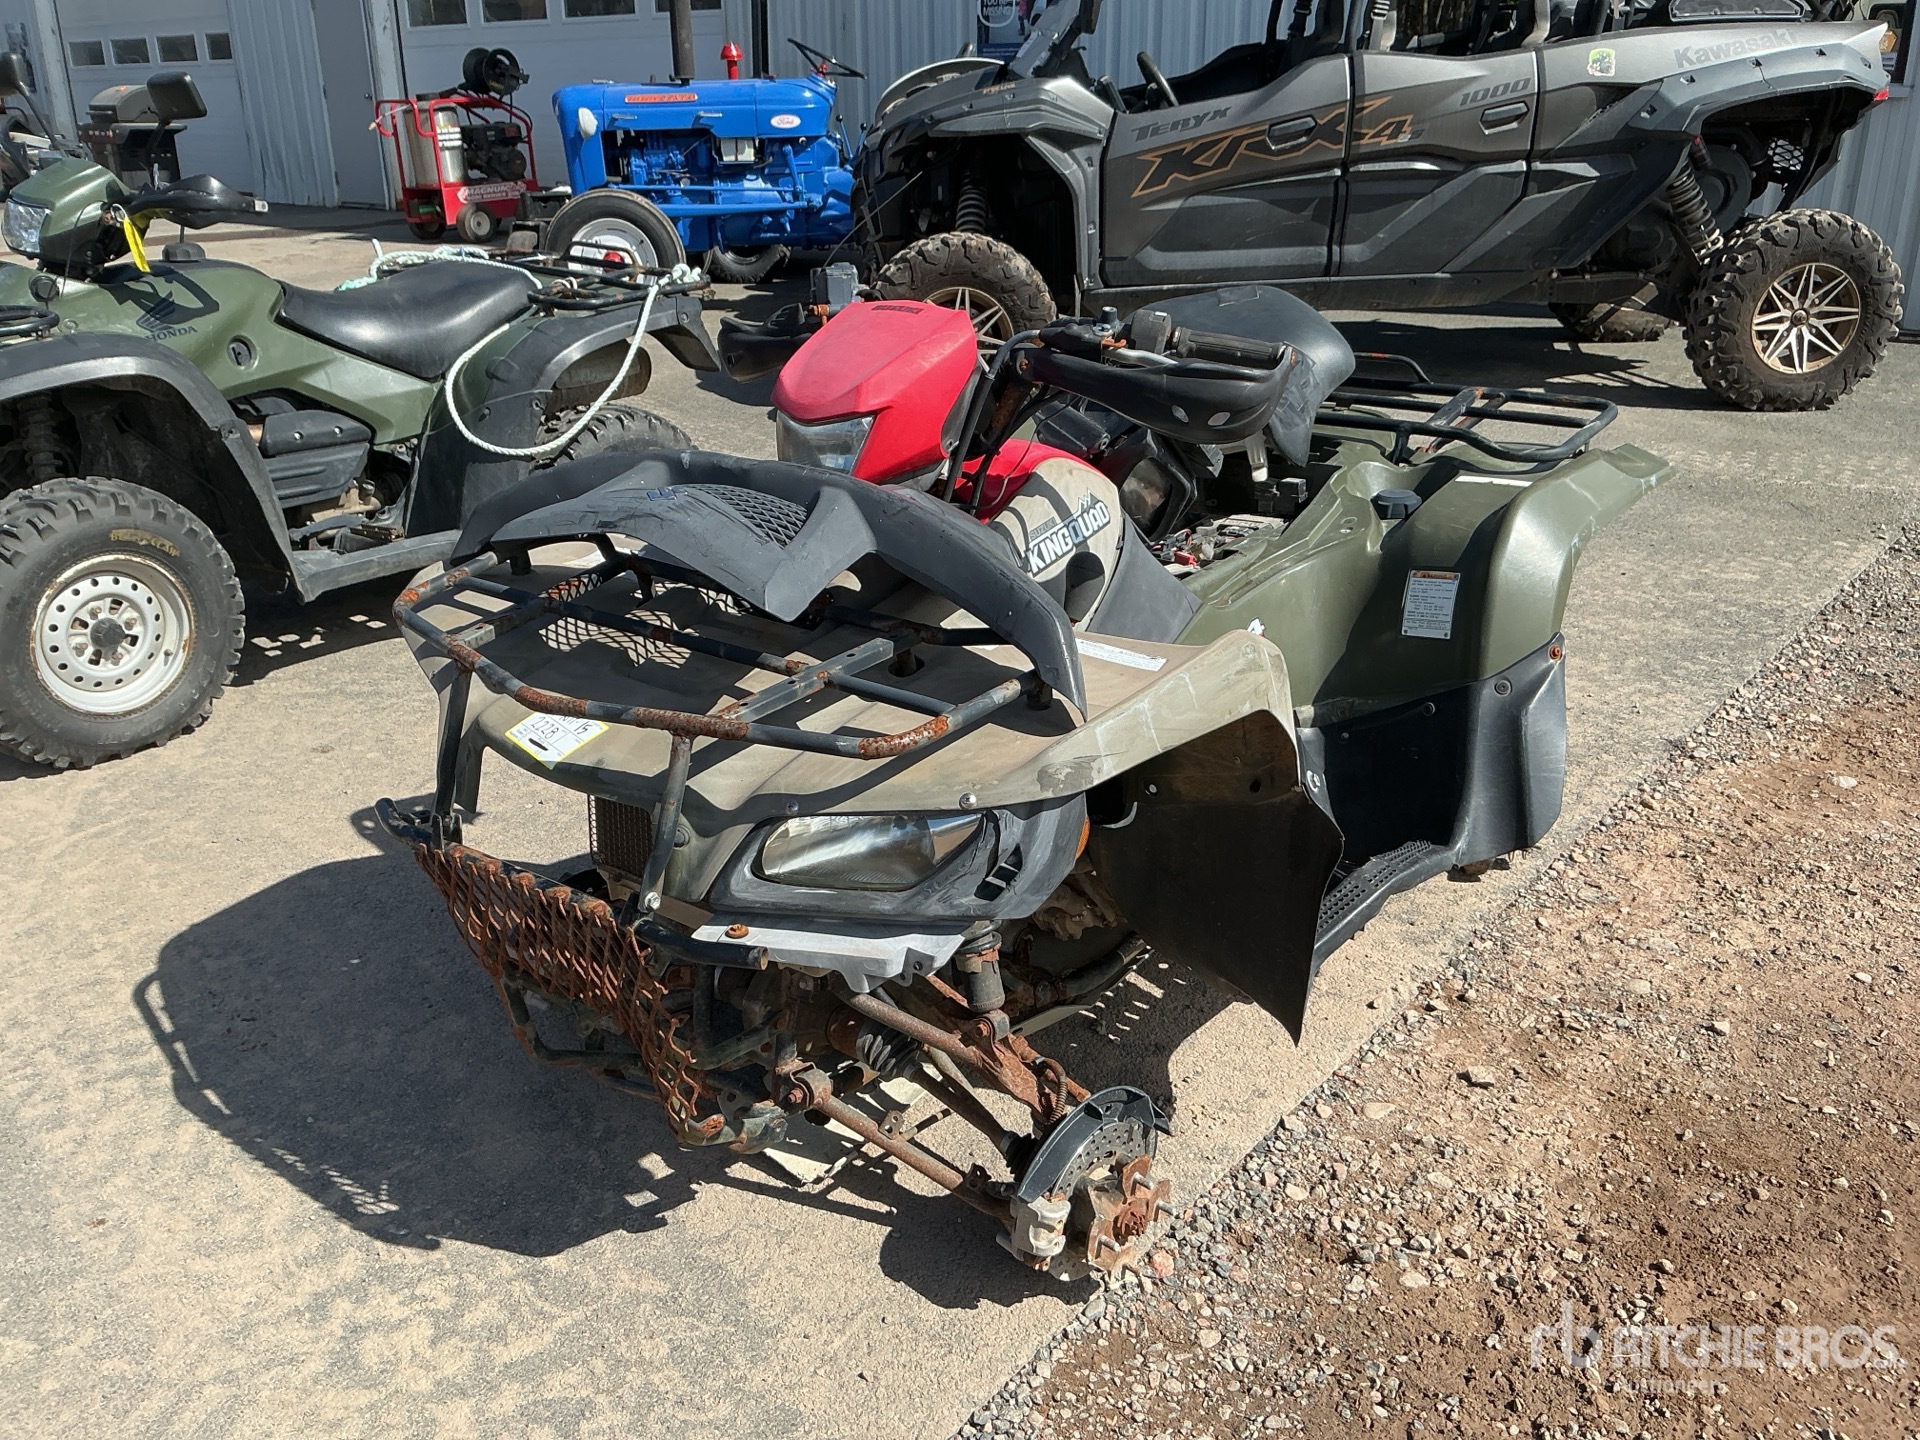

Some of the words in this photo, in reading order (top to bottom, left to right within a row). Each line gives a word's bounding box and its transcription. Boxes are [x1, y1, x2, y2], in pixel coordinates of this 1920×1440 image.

[983, 6, 1011, 16] MISSING
[1673, 28, 1797, 69] Kawasaki
[1459, 77, 1531, 107] 1000
[871, 304, 925, 315] SUZUKI
[1027, 501, 1110, 575] KINGQUAD
[1029, 517, 1057, 539] SUZUKI
[530, 716, 560, 740] 2228
